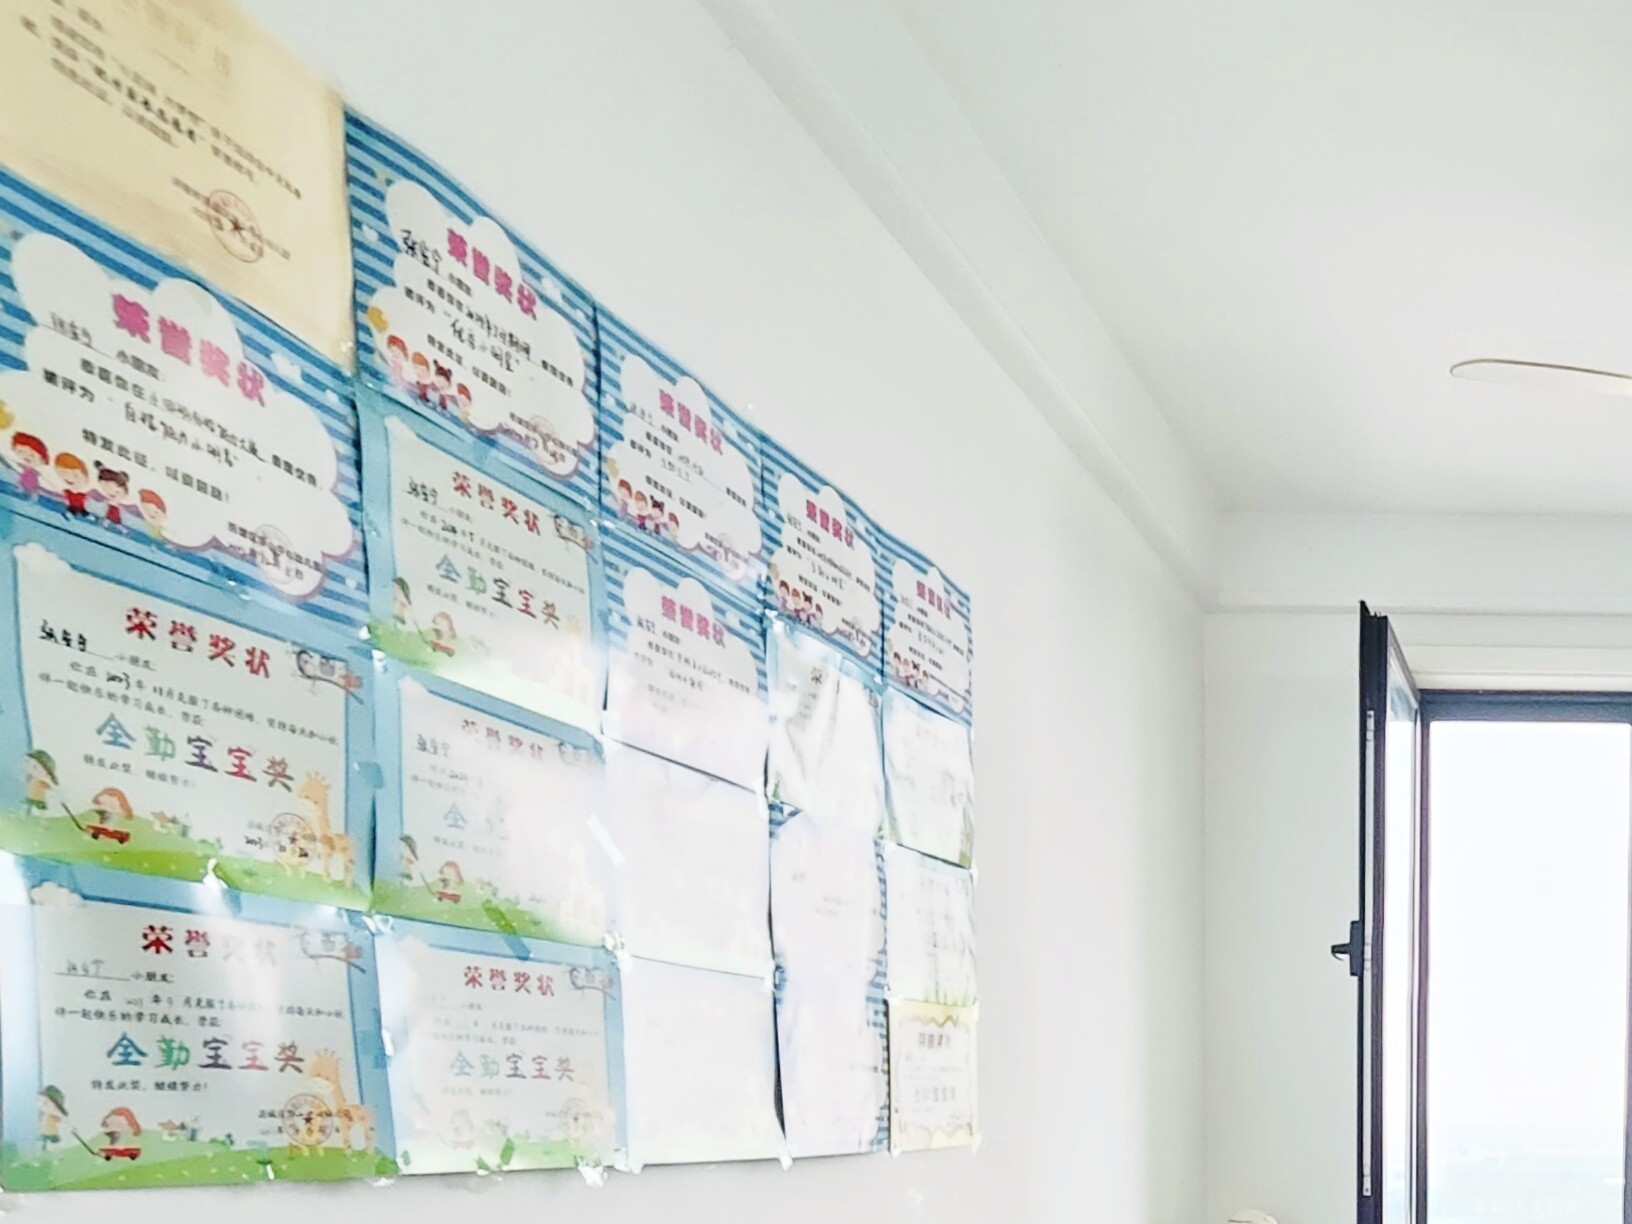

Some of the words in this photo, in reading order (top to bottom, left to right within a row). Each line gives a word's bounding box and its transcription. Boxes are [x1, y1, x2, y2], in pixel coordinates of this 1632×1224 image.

[111, 293, 266, 407] 荣誉奖状
[452, 471, 541, 536] 荣誉奖状
[435, 553, 560, 630] 全勤宝宝奖
[125, 606, 271, 679] 荣誉奖状
[96, 712, 295, 793] 全勤宝宝奖
[463, 965, 555, 997] 荣誉奖状
[106, 1032, 305, 1074] 全勤宝宝奖
[450, 1051, 575, 1083] 全勤宝宝奖
